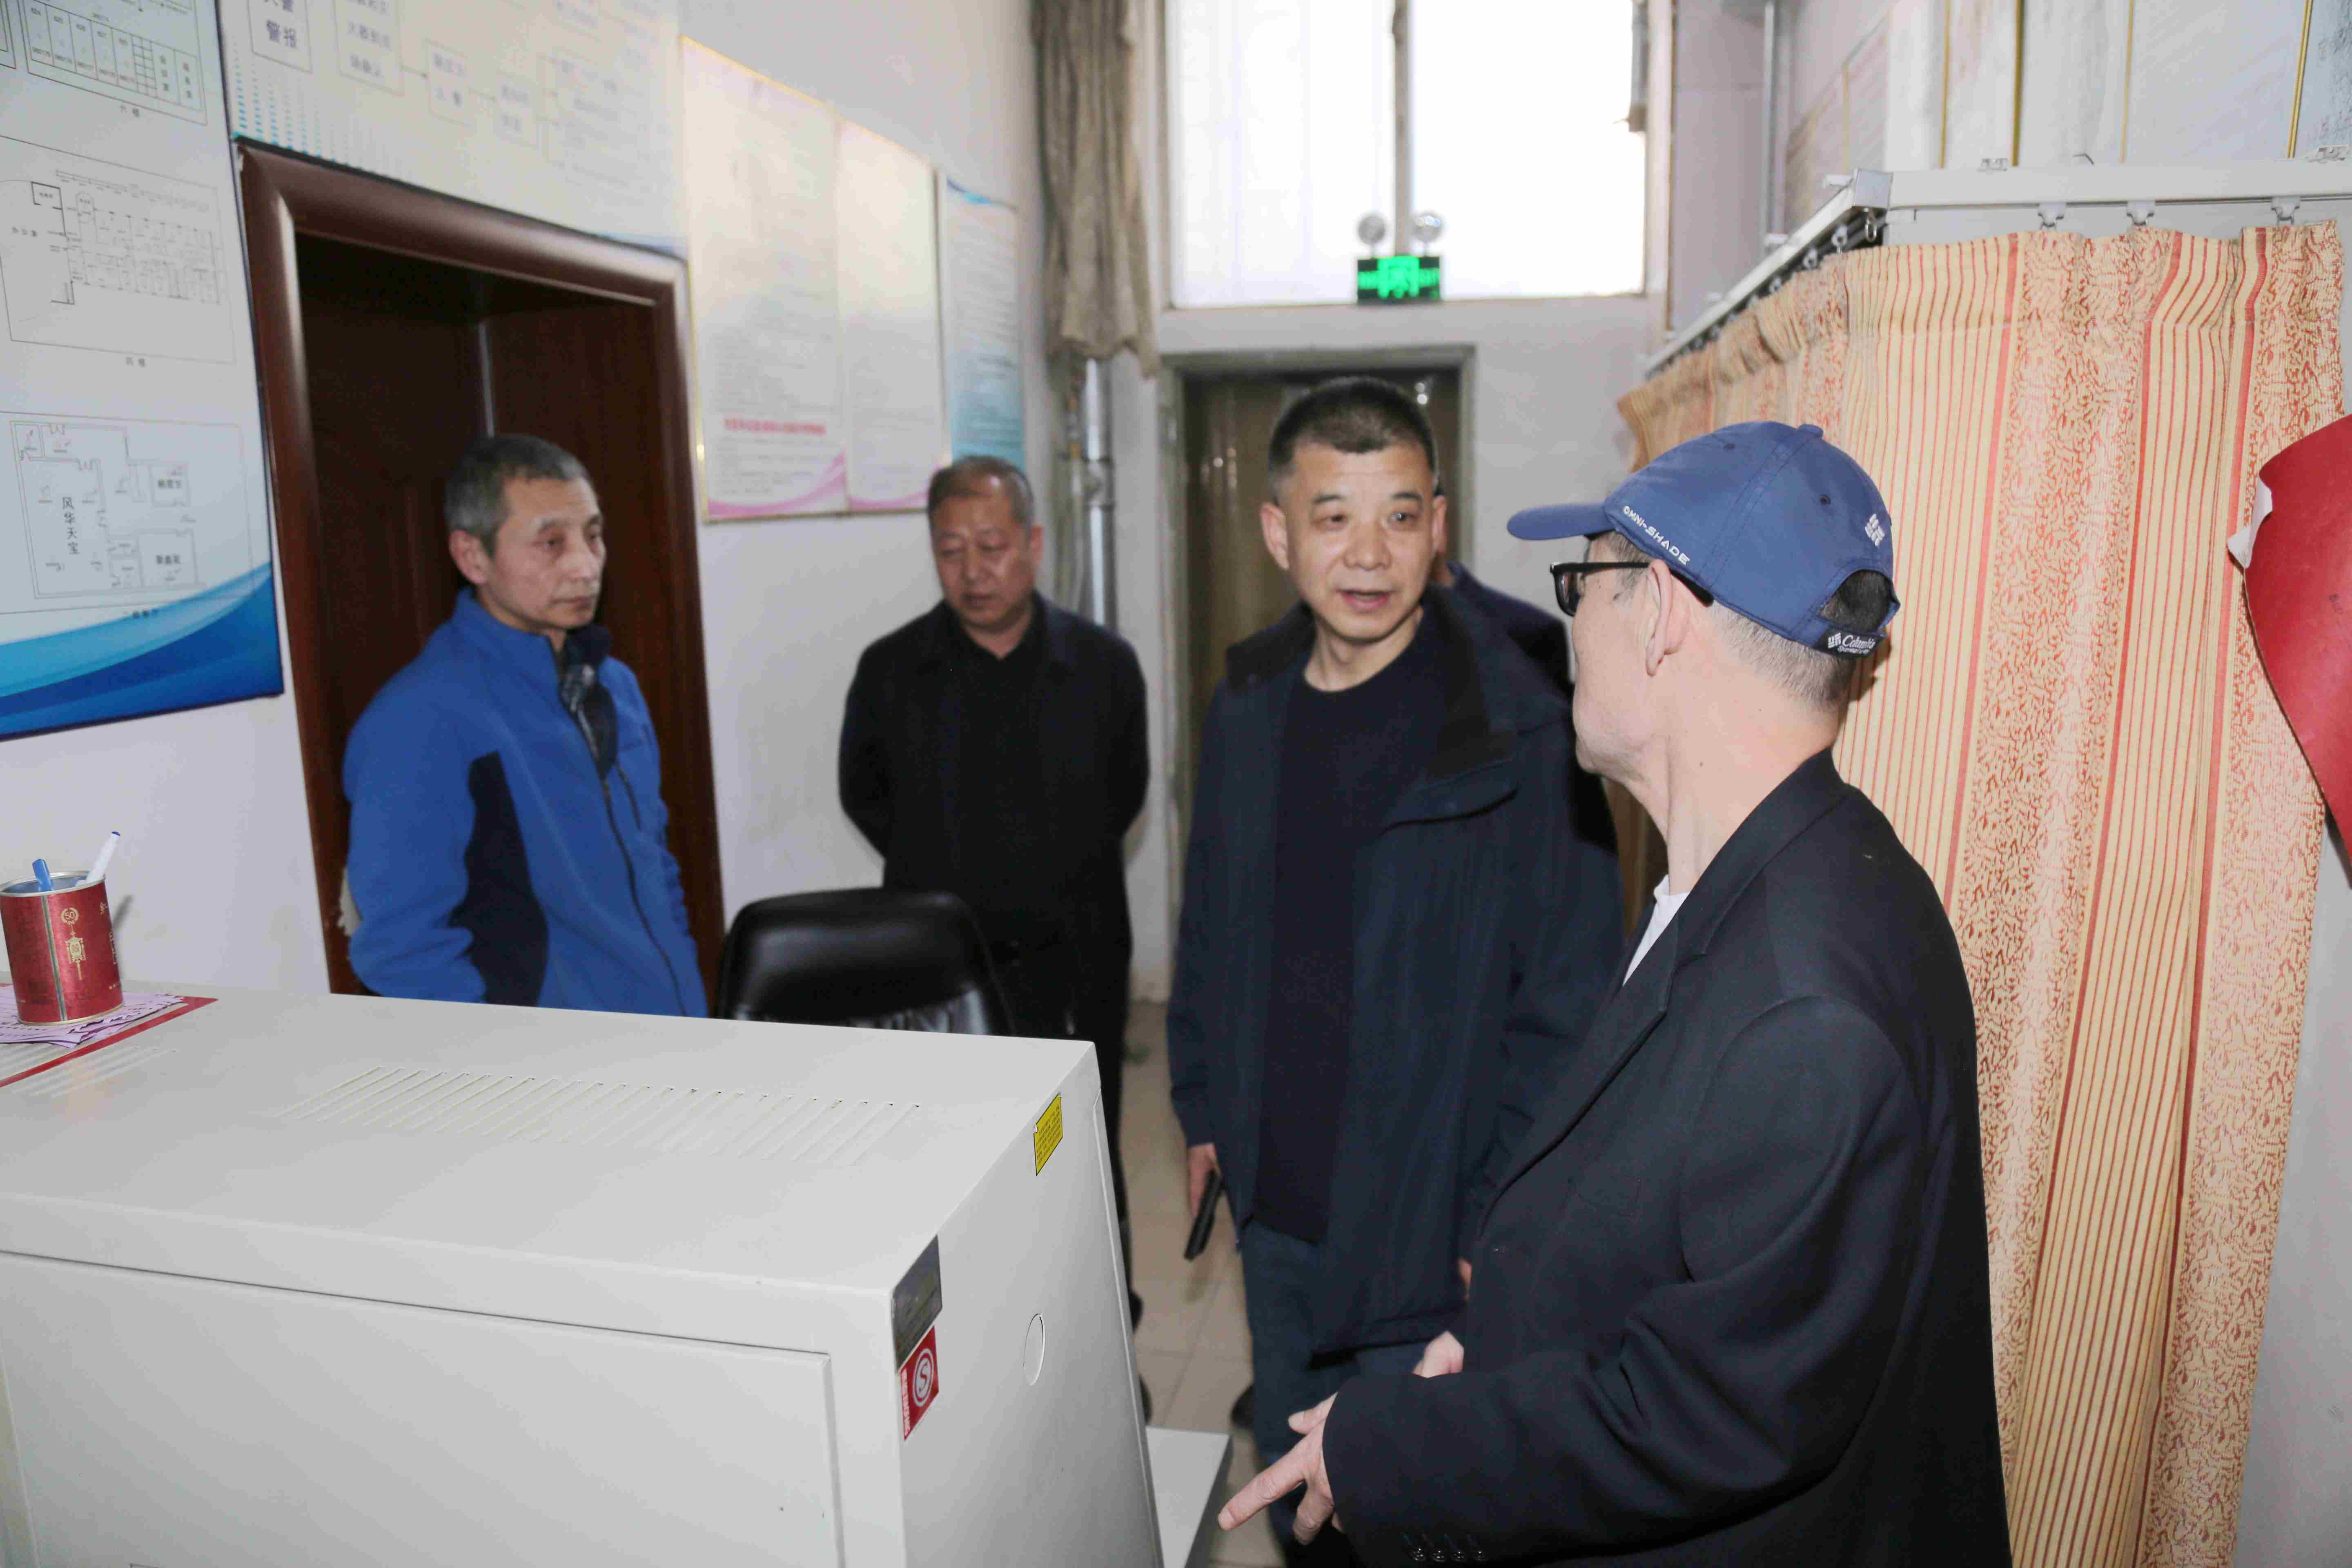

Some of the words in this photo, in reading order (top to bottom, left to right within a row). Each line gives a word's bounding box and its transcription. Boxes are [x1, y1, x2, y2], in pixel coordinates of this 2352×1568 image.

[266, 20, 297, 48] 警报
[62, 497, 80, 555] 风华天宝
[1623, 506, 1690, 566] OMNI-SHADE
